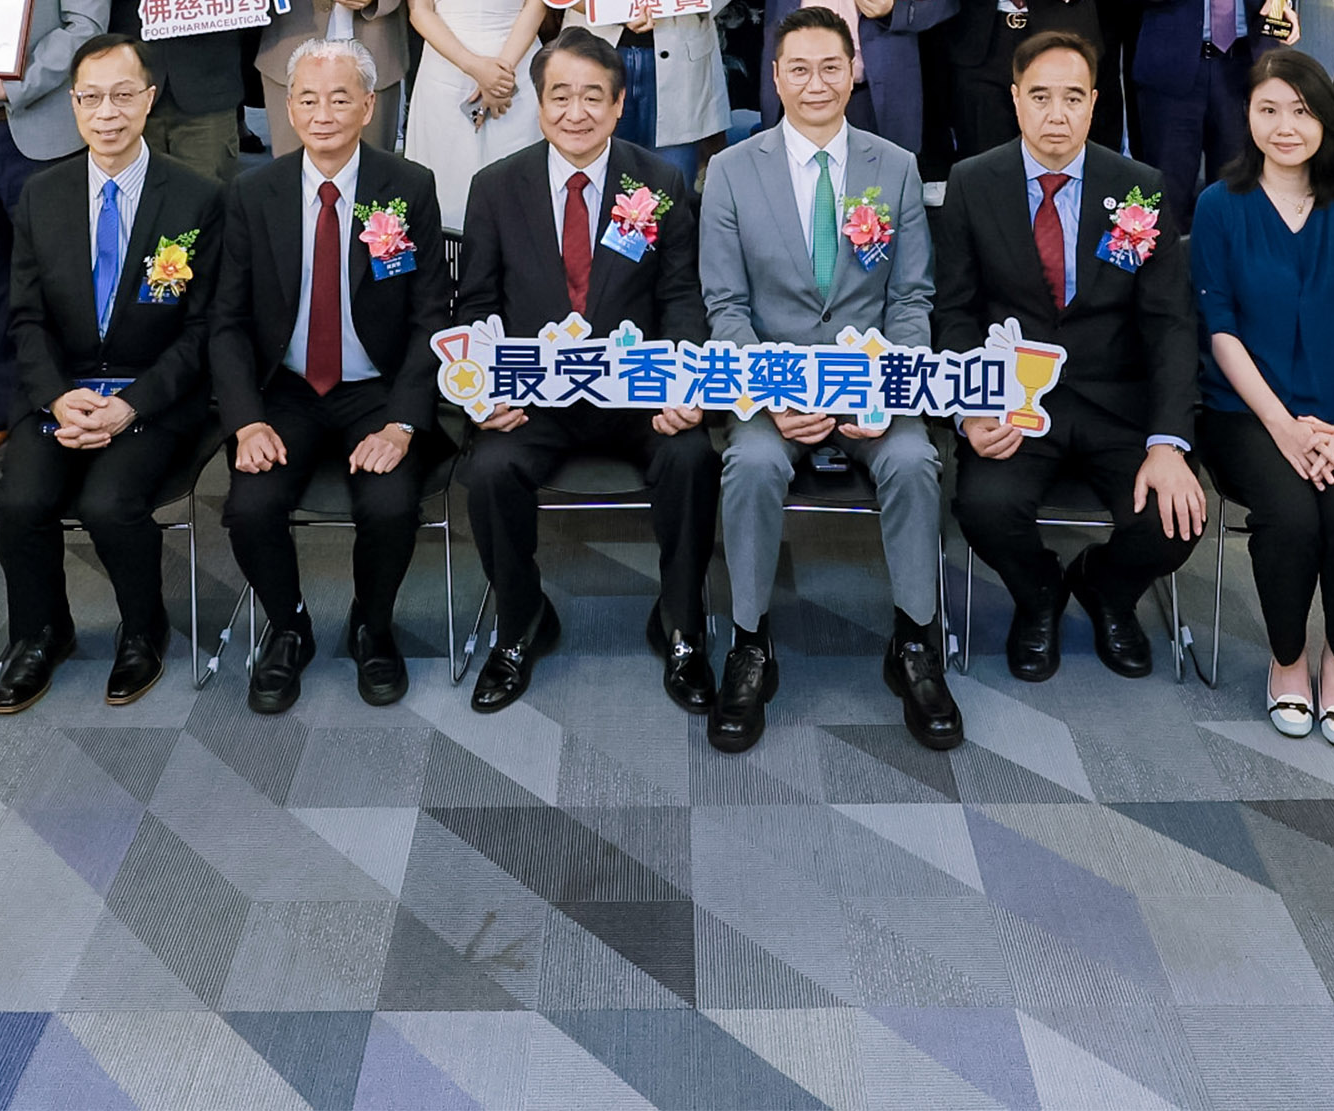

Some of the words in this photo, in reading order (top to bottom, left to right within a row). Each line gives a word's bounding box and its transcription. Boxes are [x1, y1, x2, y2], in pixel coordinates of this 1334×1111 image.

[144, 26, 170, 38] FOCI
[172, 14, 268, 34] PHARMACEUTICAL
[488, 343, 1007, 412] 最受香港藥房歡迎
